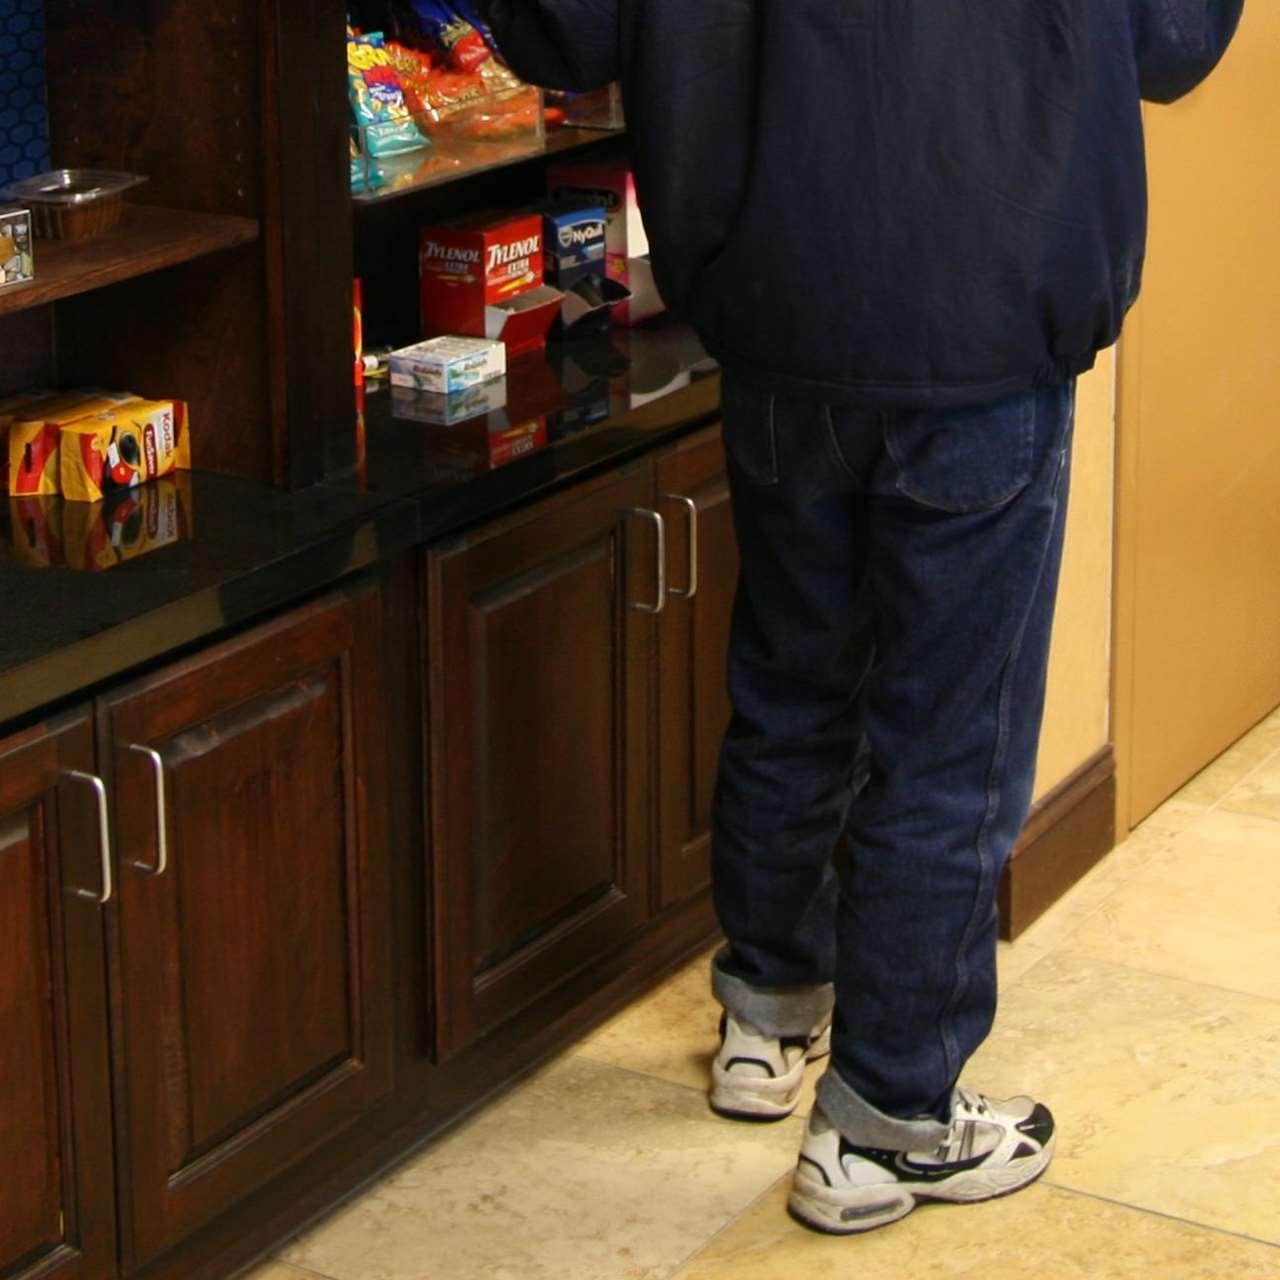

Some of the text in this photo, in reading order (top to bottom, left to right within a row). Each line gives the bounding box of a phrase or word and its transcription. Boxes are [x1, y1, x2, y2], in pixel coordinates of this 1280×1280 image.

[571, 223, 604, 244] NyQuil
[426, 240, 481, 264] TYLENOL
[486, 234, 541, 270] TYLENOL
[162, 412, 175, 456] Kodak
[145, 429, 156, 476] FunSaver
